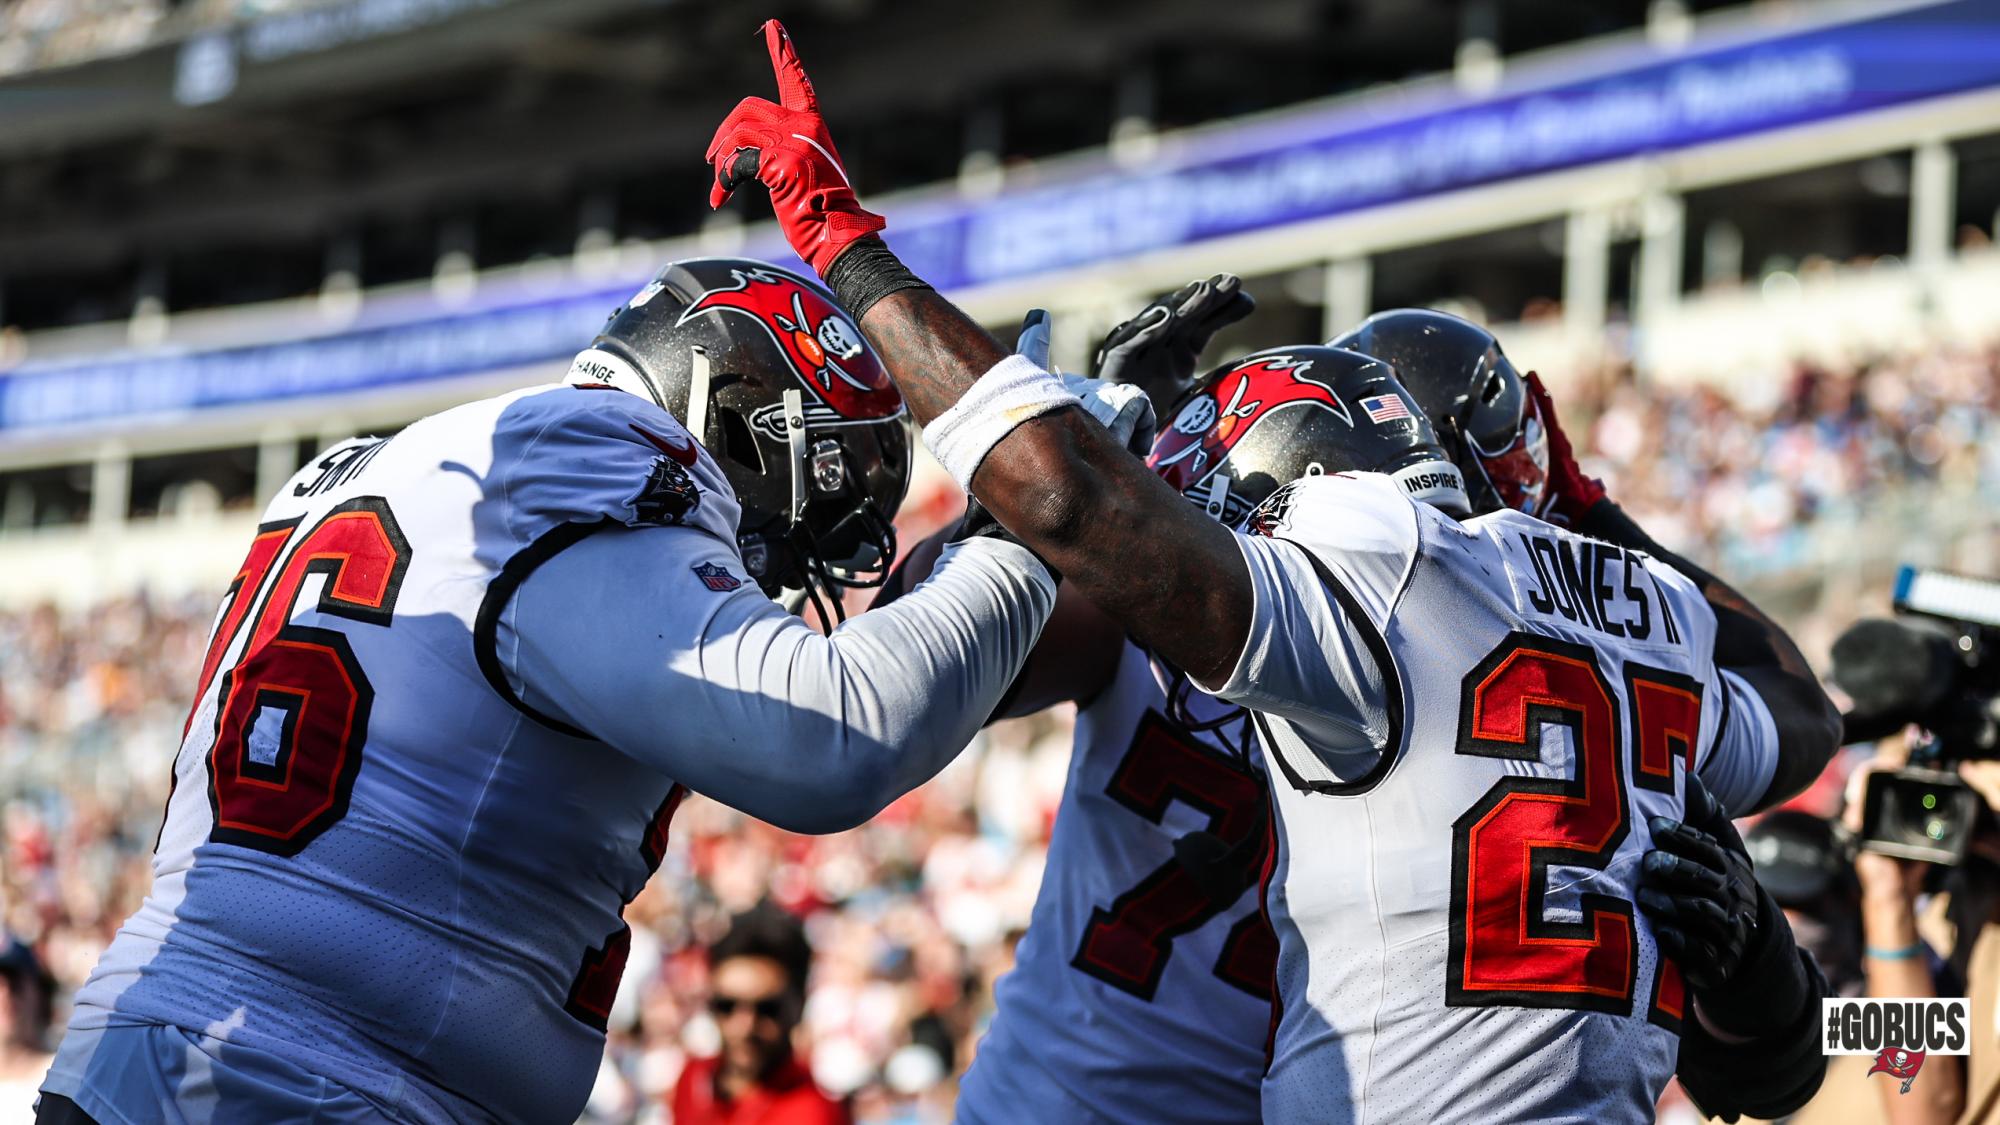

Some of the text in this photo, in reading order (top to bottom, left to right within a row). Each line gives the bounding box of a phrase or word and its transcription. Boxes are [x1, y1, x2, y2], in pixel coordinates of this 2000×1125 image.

[704, 577, 739, 589] NFL
[1404, 472, 1459, 493] INSPIRE
[154, 495, 413, 856] 76
[1518, 532, 1651, 640] JONES
[1070, 707, 1280, 1002] 7
[1445, 631, 1704, 1036] 27
